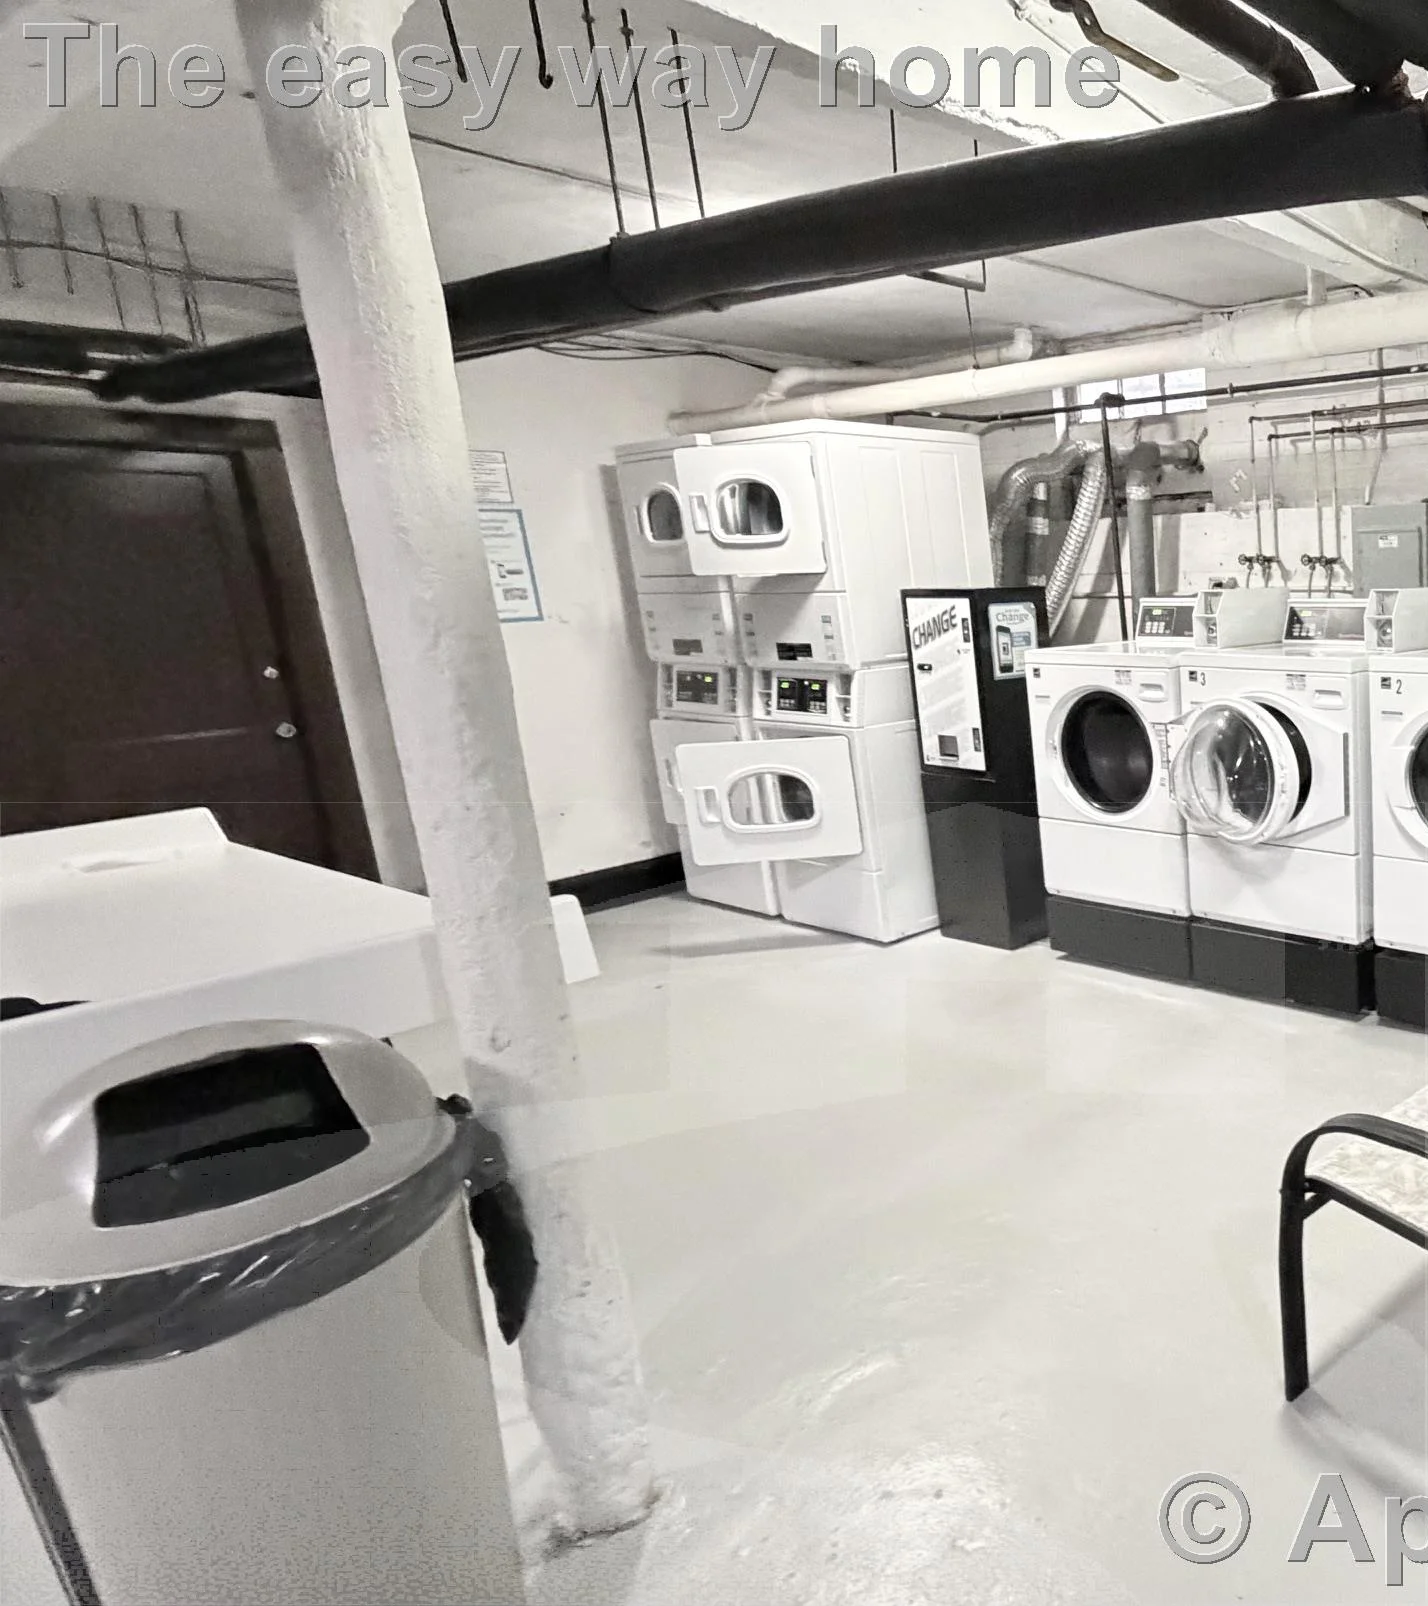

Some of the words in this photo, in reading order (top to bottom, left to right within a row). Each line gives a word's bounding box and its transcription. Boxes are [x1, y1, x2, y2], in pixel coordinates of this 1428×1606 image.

[996, 612, 1030, 622] Change
[913, 605, 957, 650] CHANGE
[1200, 671, 1206, 687] 3
[1396, 679, 1403, 695] 2
